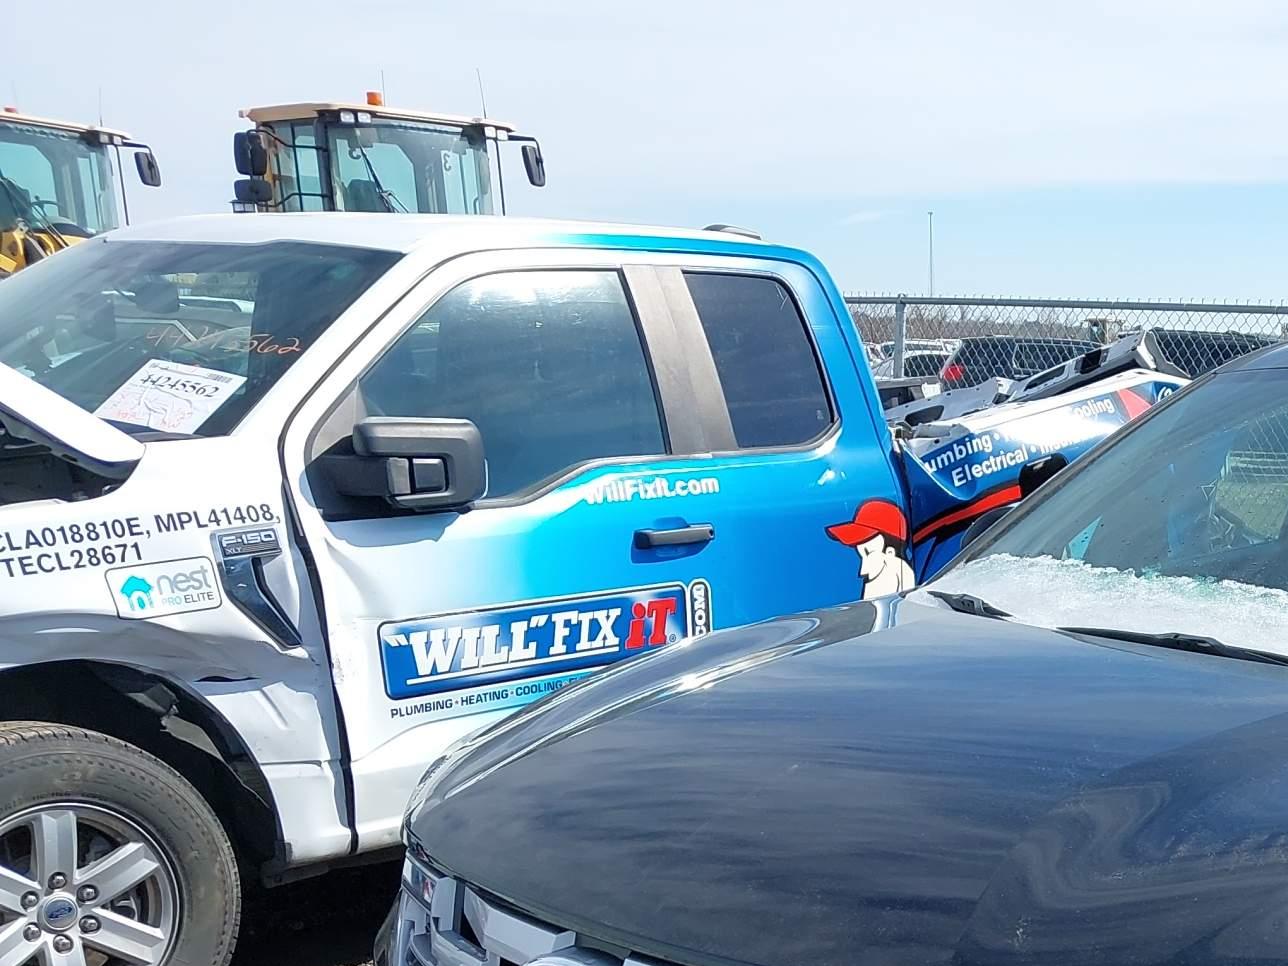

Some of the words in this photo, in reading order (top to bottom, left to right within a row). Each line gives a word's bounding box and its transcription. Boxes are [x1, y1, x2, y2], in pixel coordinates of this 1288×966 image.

[140, 373, 221, 398] 44245562
[951, 446, 1029, 488] Electrical
[153, 503, 281, 534] MPL41408,
[221, 530, 276, 547] F-150
[0, 541, 143, 578] TECL28671
[155, 565, 212, 596] nest
[161, 596, 182, 606] PRO
[184, 591, 215, 604] ELITE
[543, 606, 622, 656] FIX
[390, 698, 454, 719] PLUMBING
[460, 688, 509, 707] HEATING
[515, 679, 563, 698] COOLING
